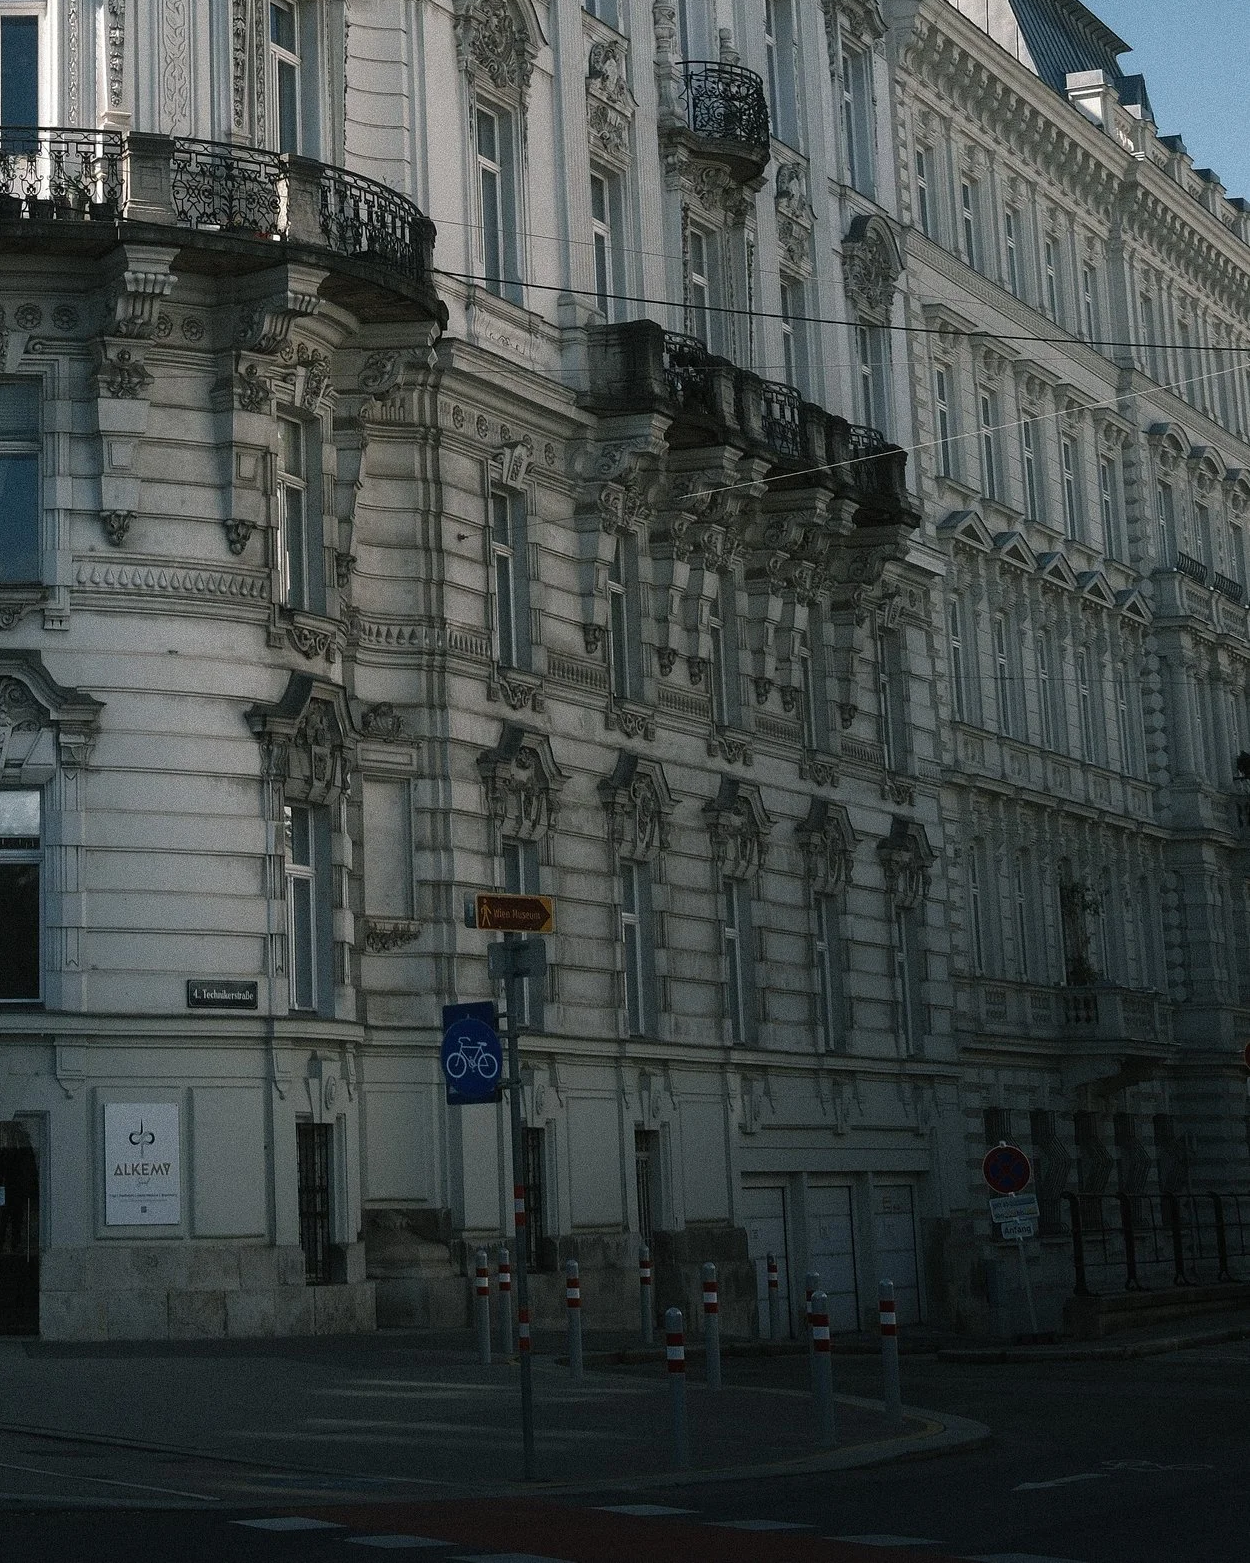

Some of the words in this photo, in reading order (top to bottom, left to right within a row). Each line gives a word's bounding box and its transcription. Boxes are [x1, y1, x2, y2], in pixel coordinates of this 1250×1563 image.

[493, 908, 511, 919] Wien
[512, 909, 541, 920] Museum
[202, 989, 254, 1001] Technikerstraße
[113, 1163, 171, 1176] ALKEMY
[1004, 1226, 1032, 1234] Anfang
